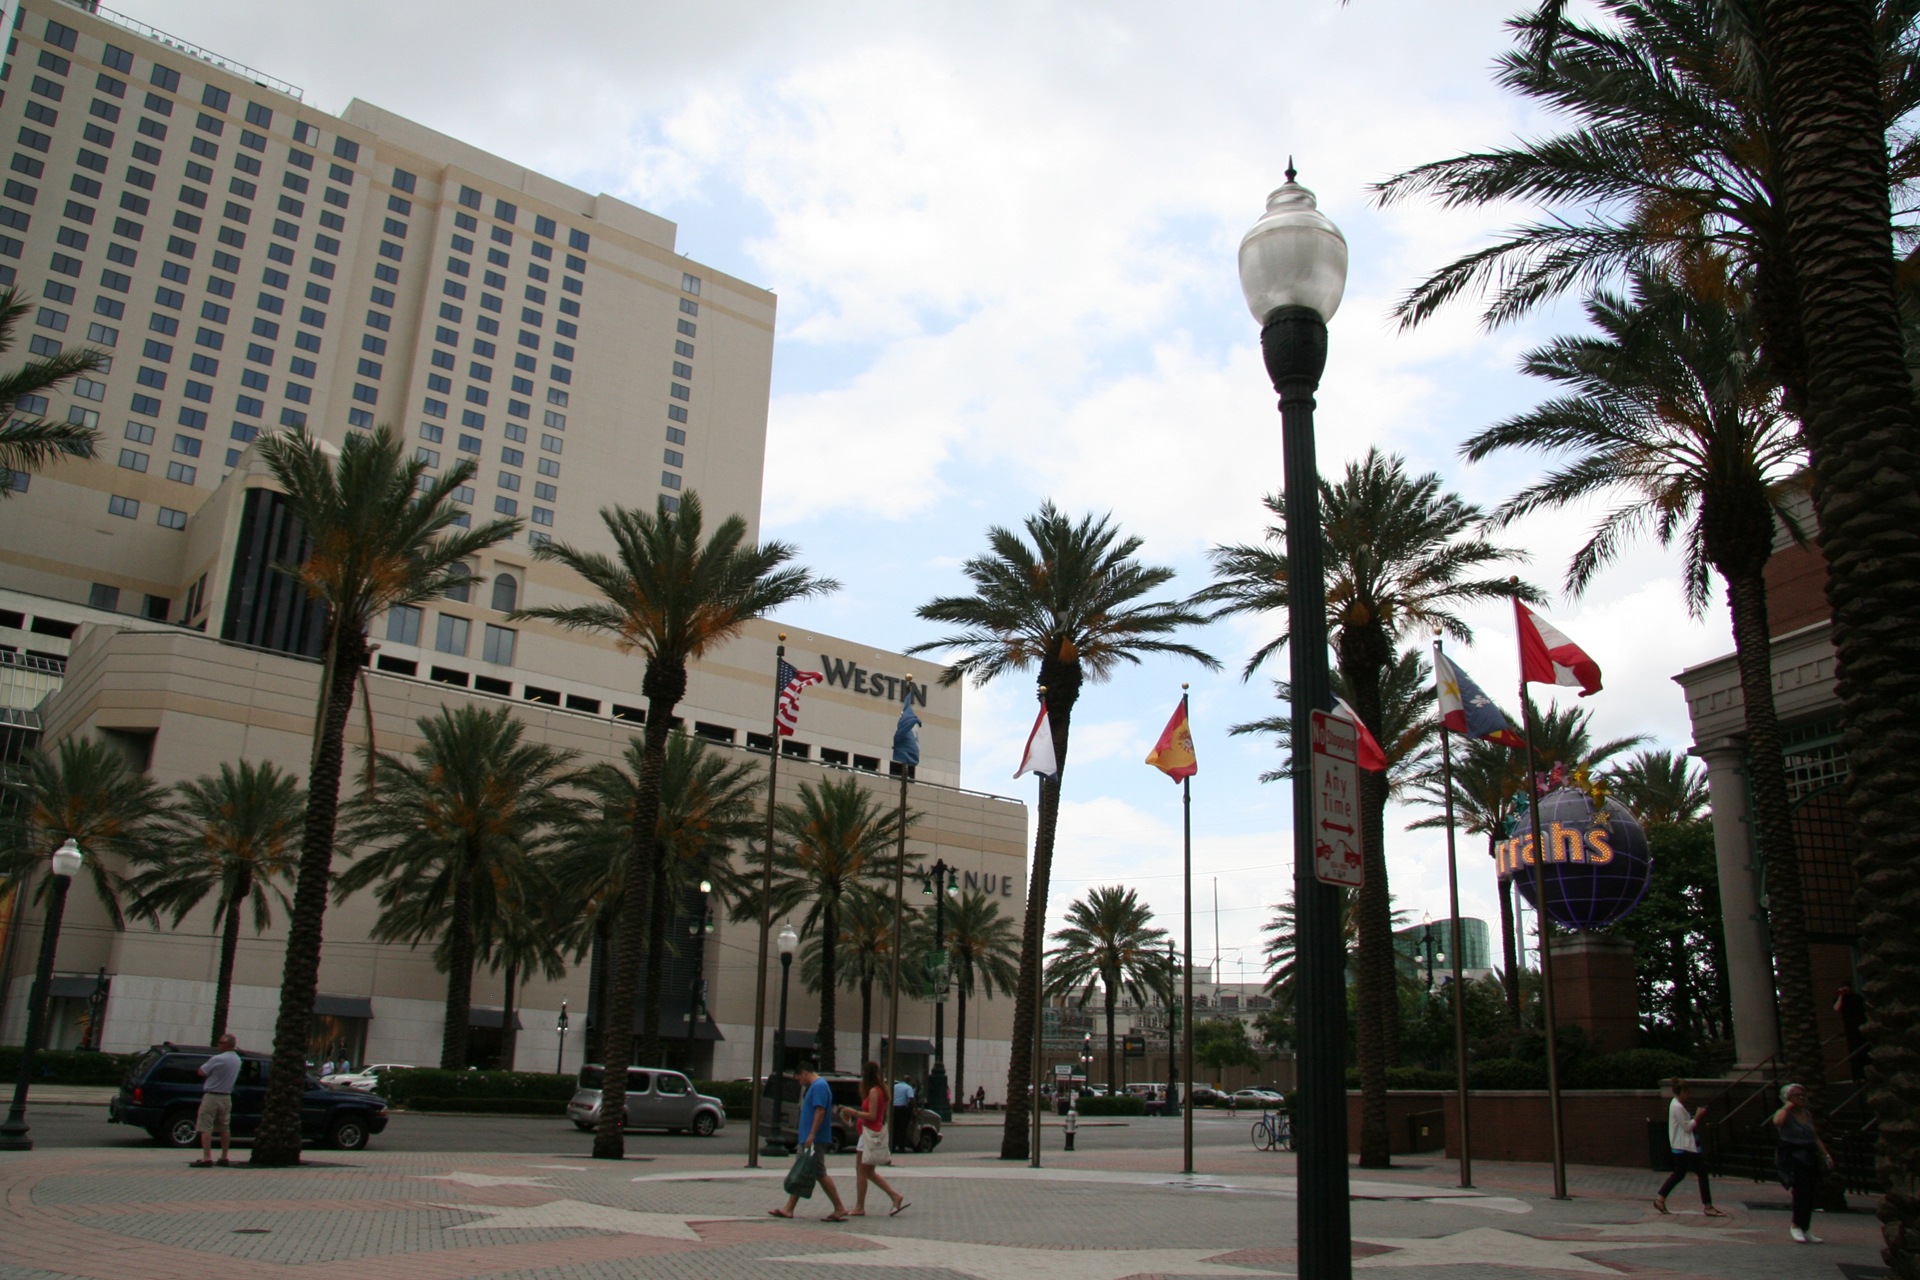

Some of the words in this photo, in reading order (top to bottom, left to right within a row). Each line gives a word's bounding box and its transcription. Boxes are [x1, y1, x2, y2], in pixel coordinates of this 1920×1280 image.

[821, 654, 927, 707] WESTIN
[1312, 720, 1326, 745] No
[1327, 729, 1355, 756] Stopping
[1324, 770, 1347, 799] Any
[1322, 792, 1351, 817] Time
